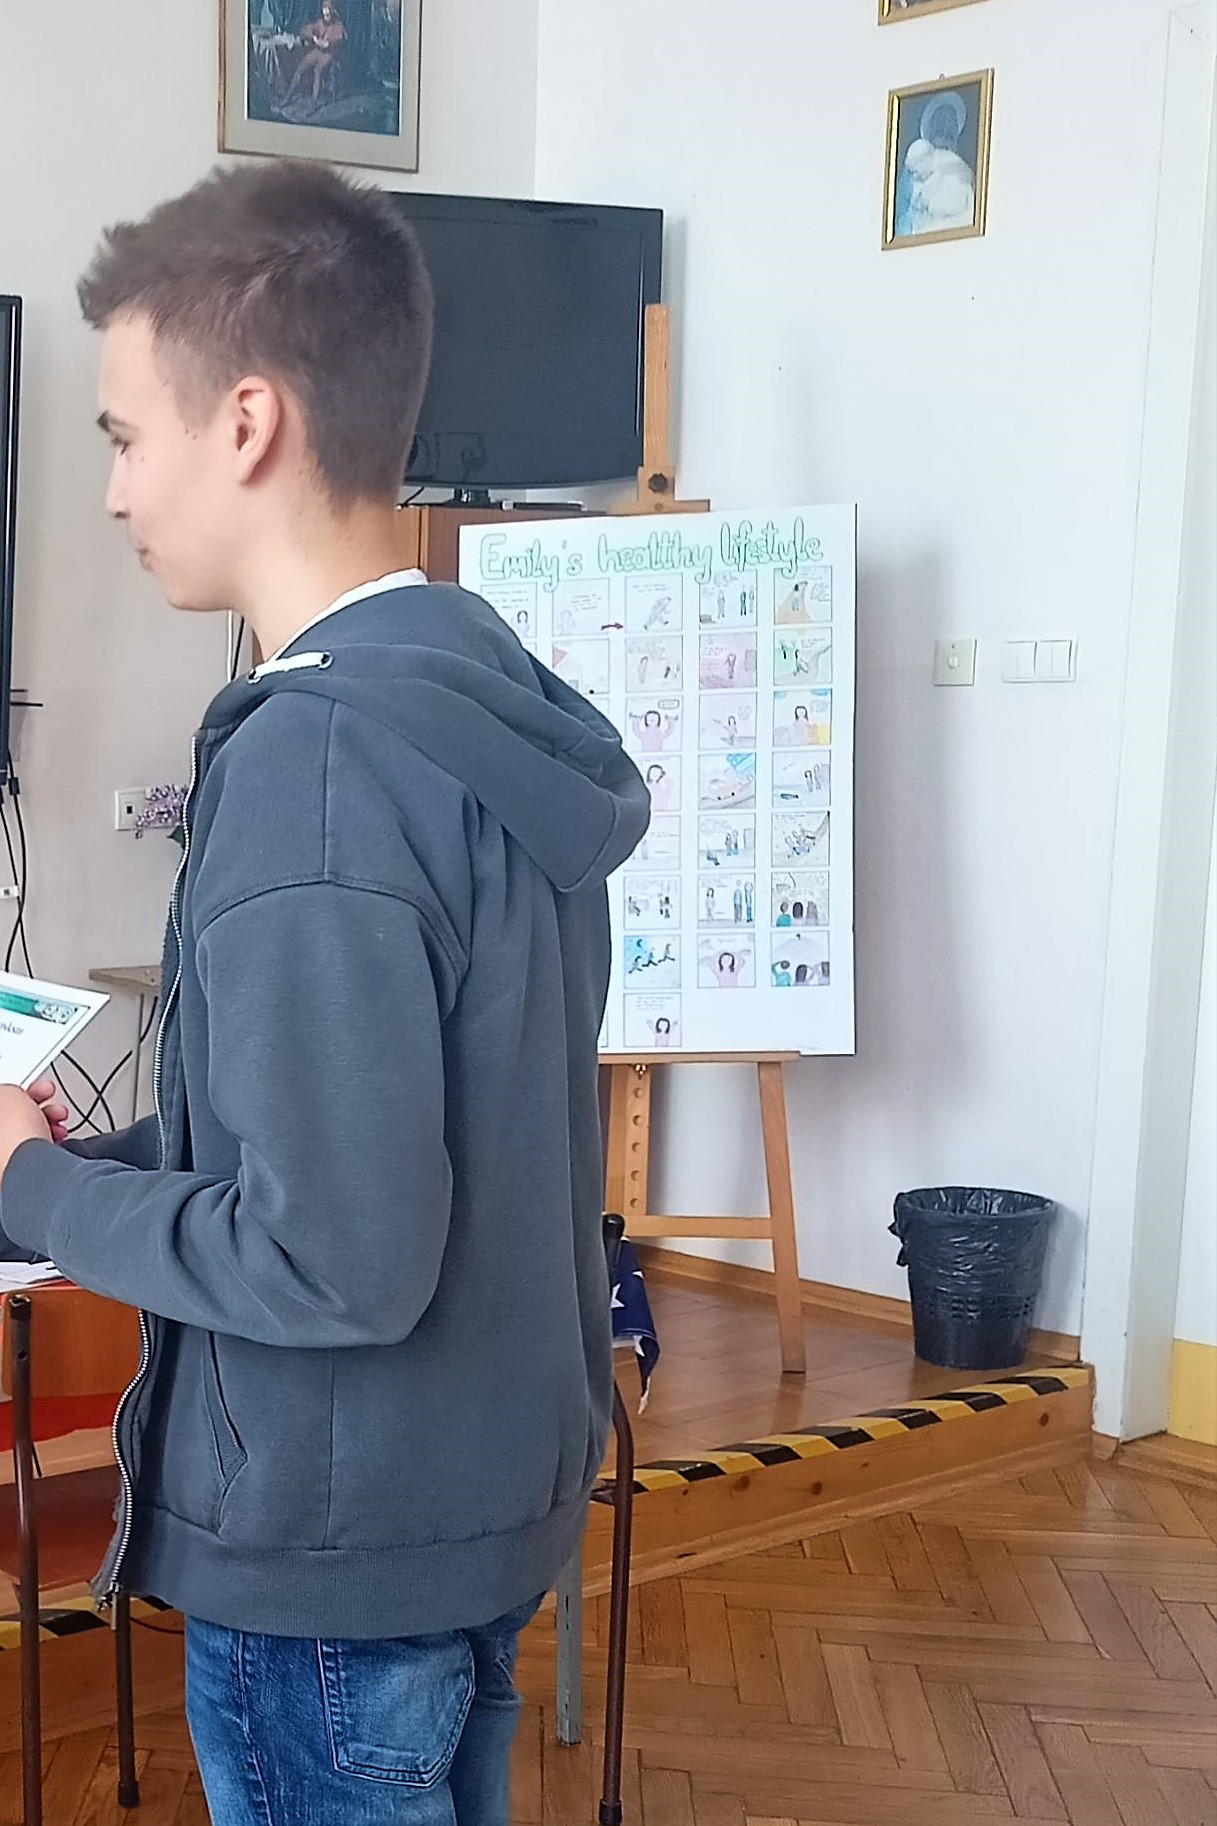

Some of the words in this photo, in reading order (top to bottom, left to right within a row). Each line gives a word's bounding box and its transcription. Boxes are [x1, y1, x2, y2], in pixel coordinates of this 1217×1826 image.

[480, 532, 583, 593] Emily's
[598, 531, 713, 584] healthy
[720, 516, 824, 579] lifestyle
